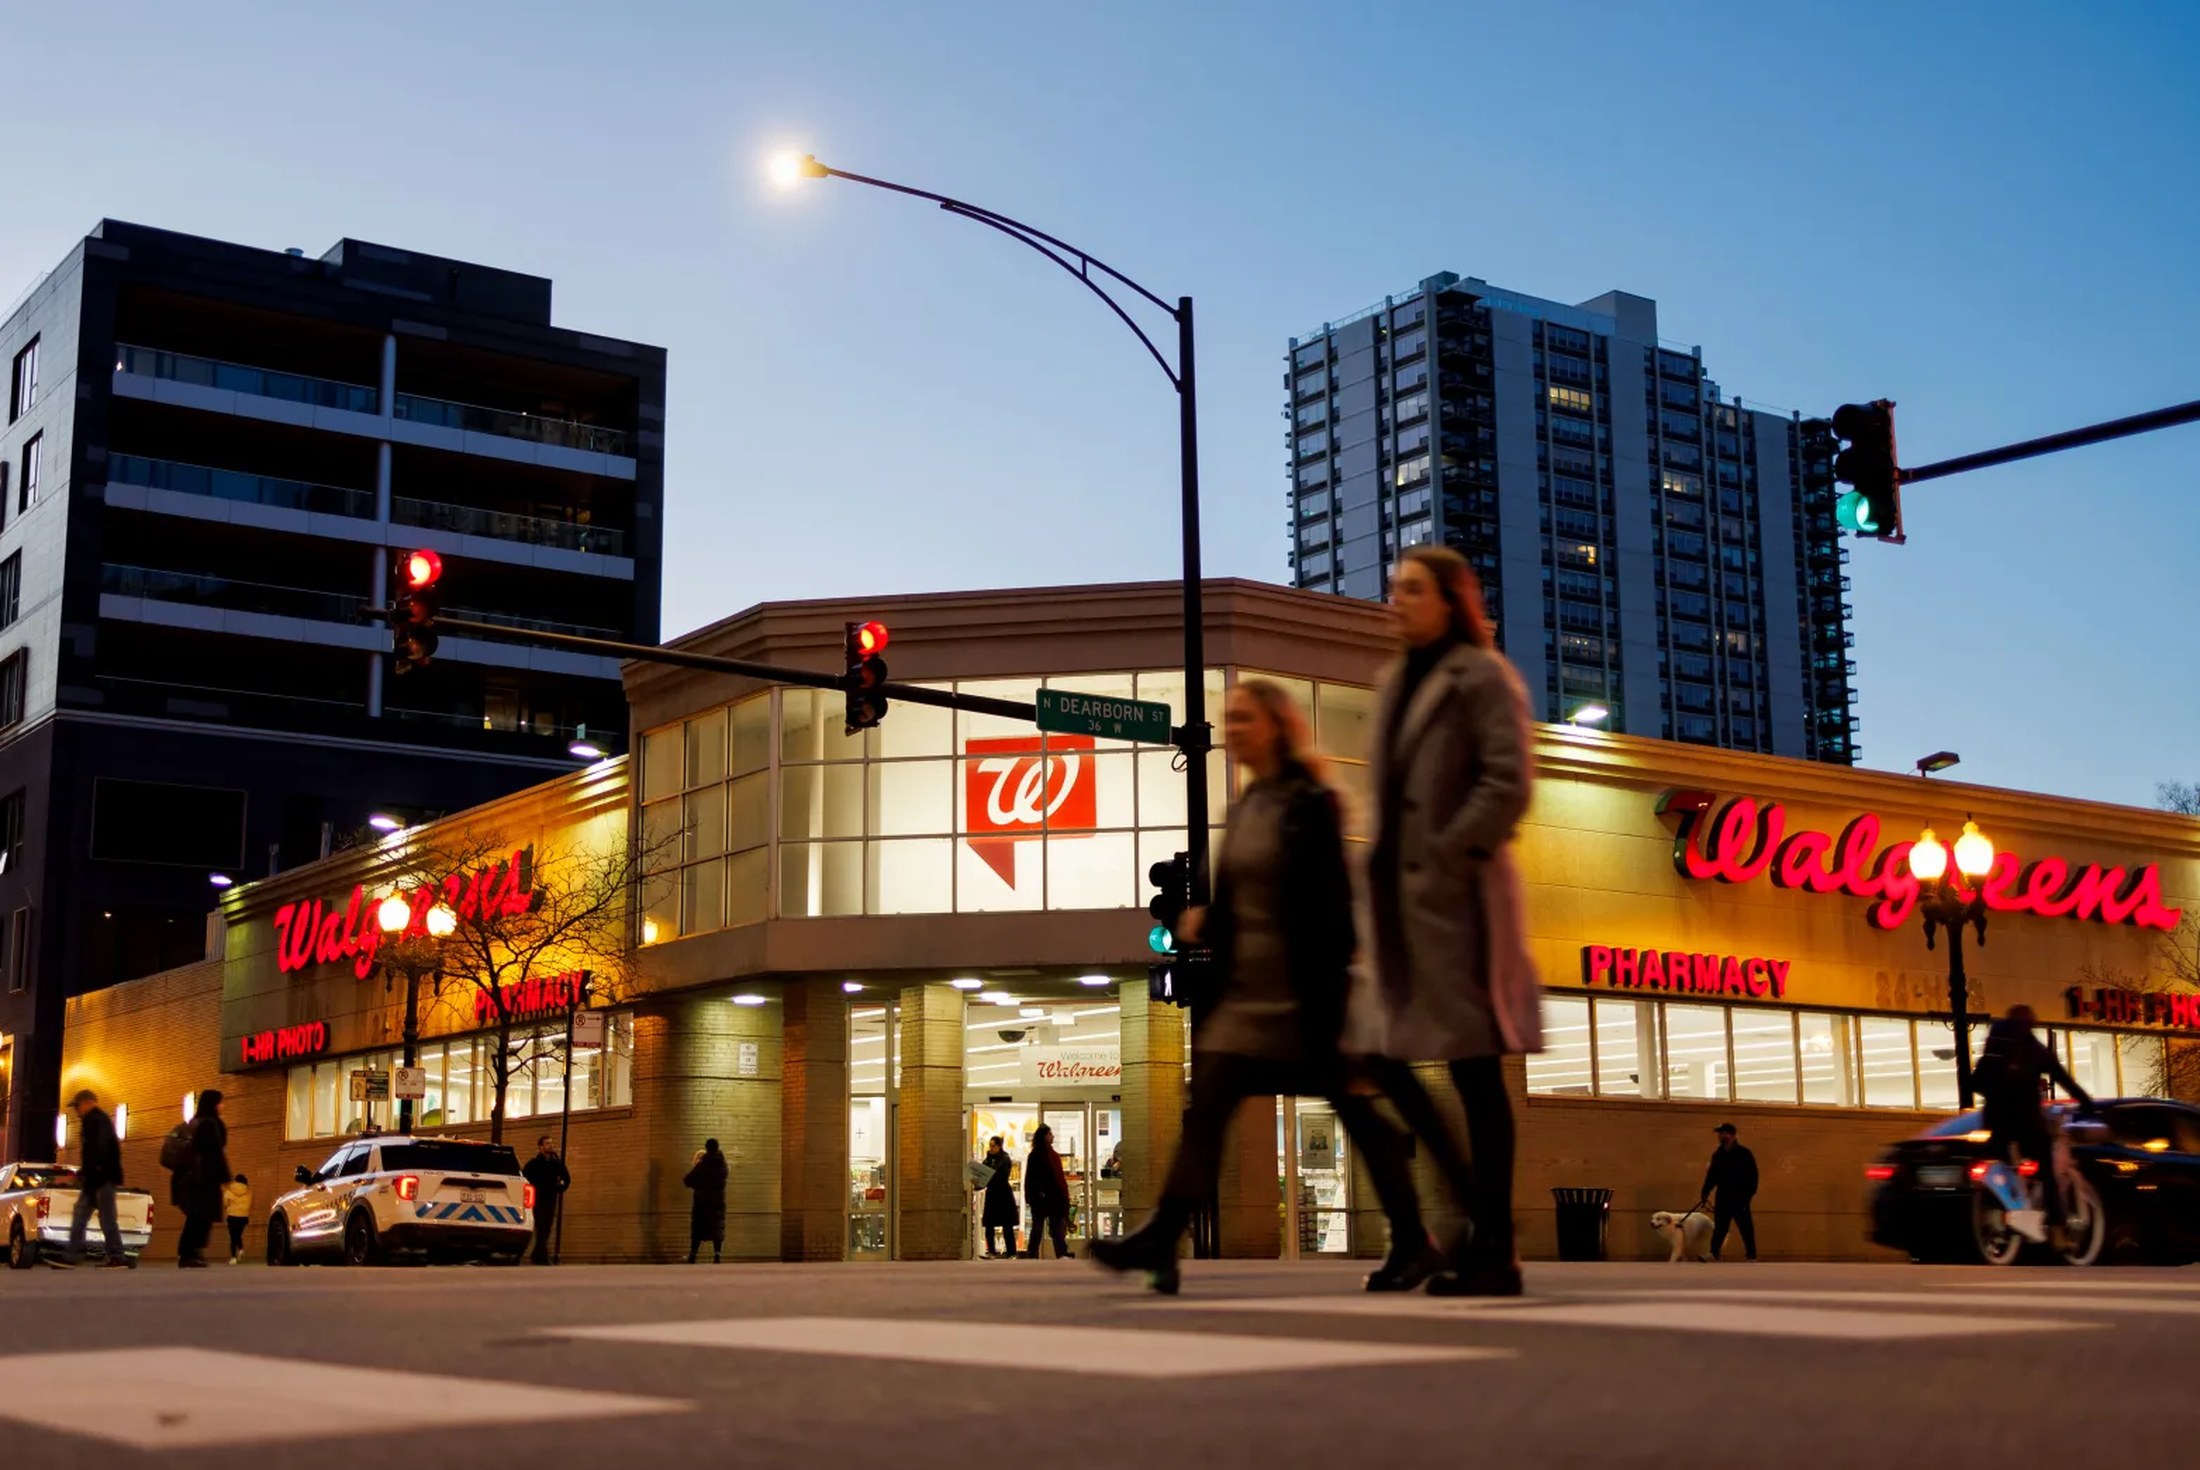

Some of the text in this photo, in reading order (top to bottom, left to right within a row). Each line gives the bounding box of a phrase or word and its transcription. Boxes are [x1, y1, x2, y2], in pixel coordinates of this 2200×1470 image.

[1043, 697, 1164, 722] N DEARBORN ST
[1088, 719, 1102, 731] 36
[977, 748, 1080, 825] W
[275, 848, 537, 981] Walgeens
[1583, 944, 1790, 998] PHARMACY
[241, 1020, 325, 1064] 1-HR PHOTO
[1060, 1051, 1107, 1061] Welcome
